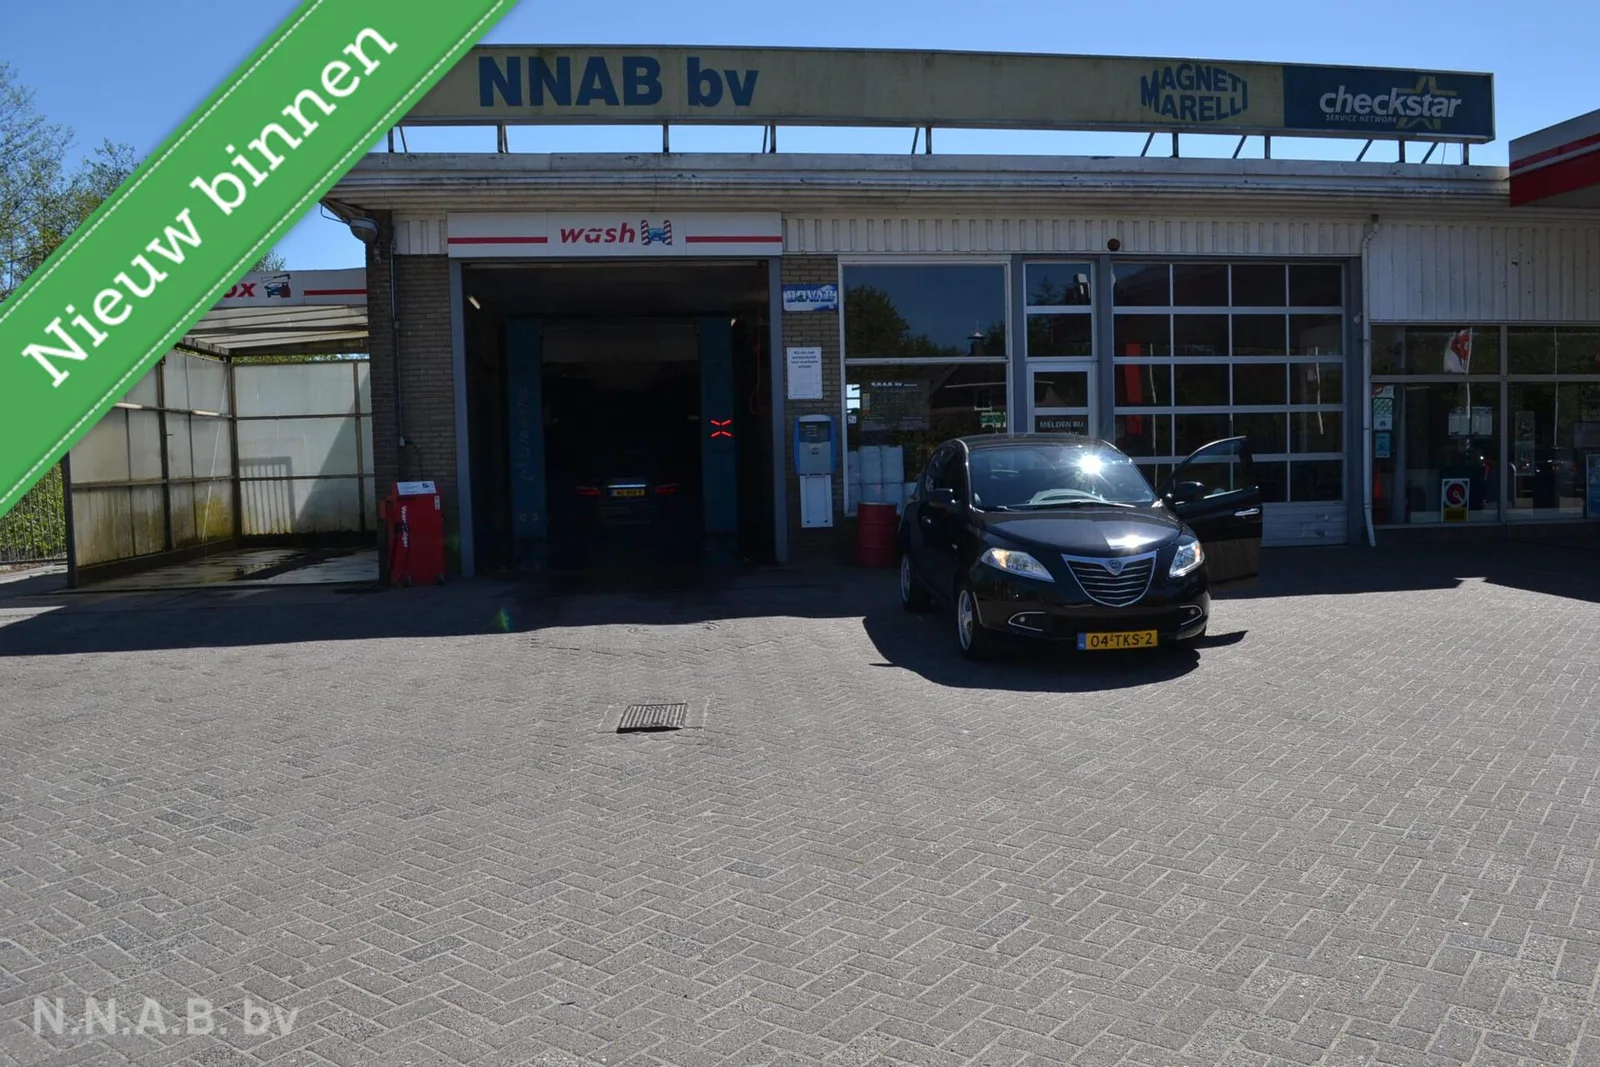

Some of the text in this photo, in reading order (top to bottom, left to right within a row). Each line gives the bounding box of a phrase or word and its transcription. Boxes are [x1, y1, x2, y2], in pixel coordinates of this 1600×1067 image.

[478, 56, 759, 107] NNAB bv
[1140, 63, 1248, 98] MAGNETI
[1140, 87, 1248, 121] MARELLI
[1319, 85, 1462, 118] checkstar
[1325, 113, 1398, 124] SERVICE NETWORK
[560, 222, 636, 244] wash
[1039, 420, 1071, 428] MELDEN
[1090, 632, 1154, 648] 04-TKS-2
